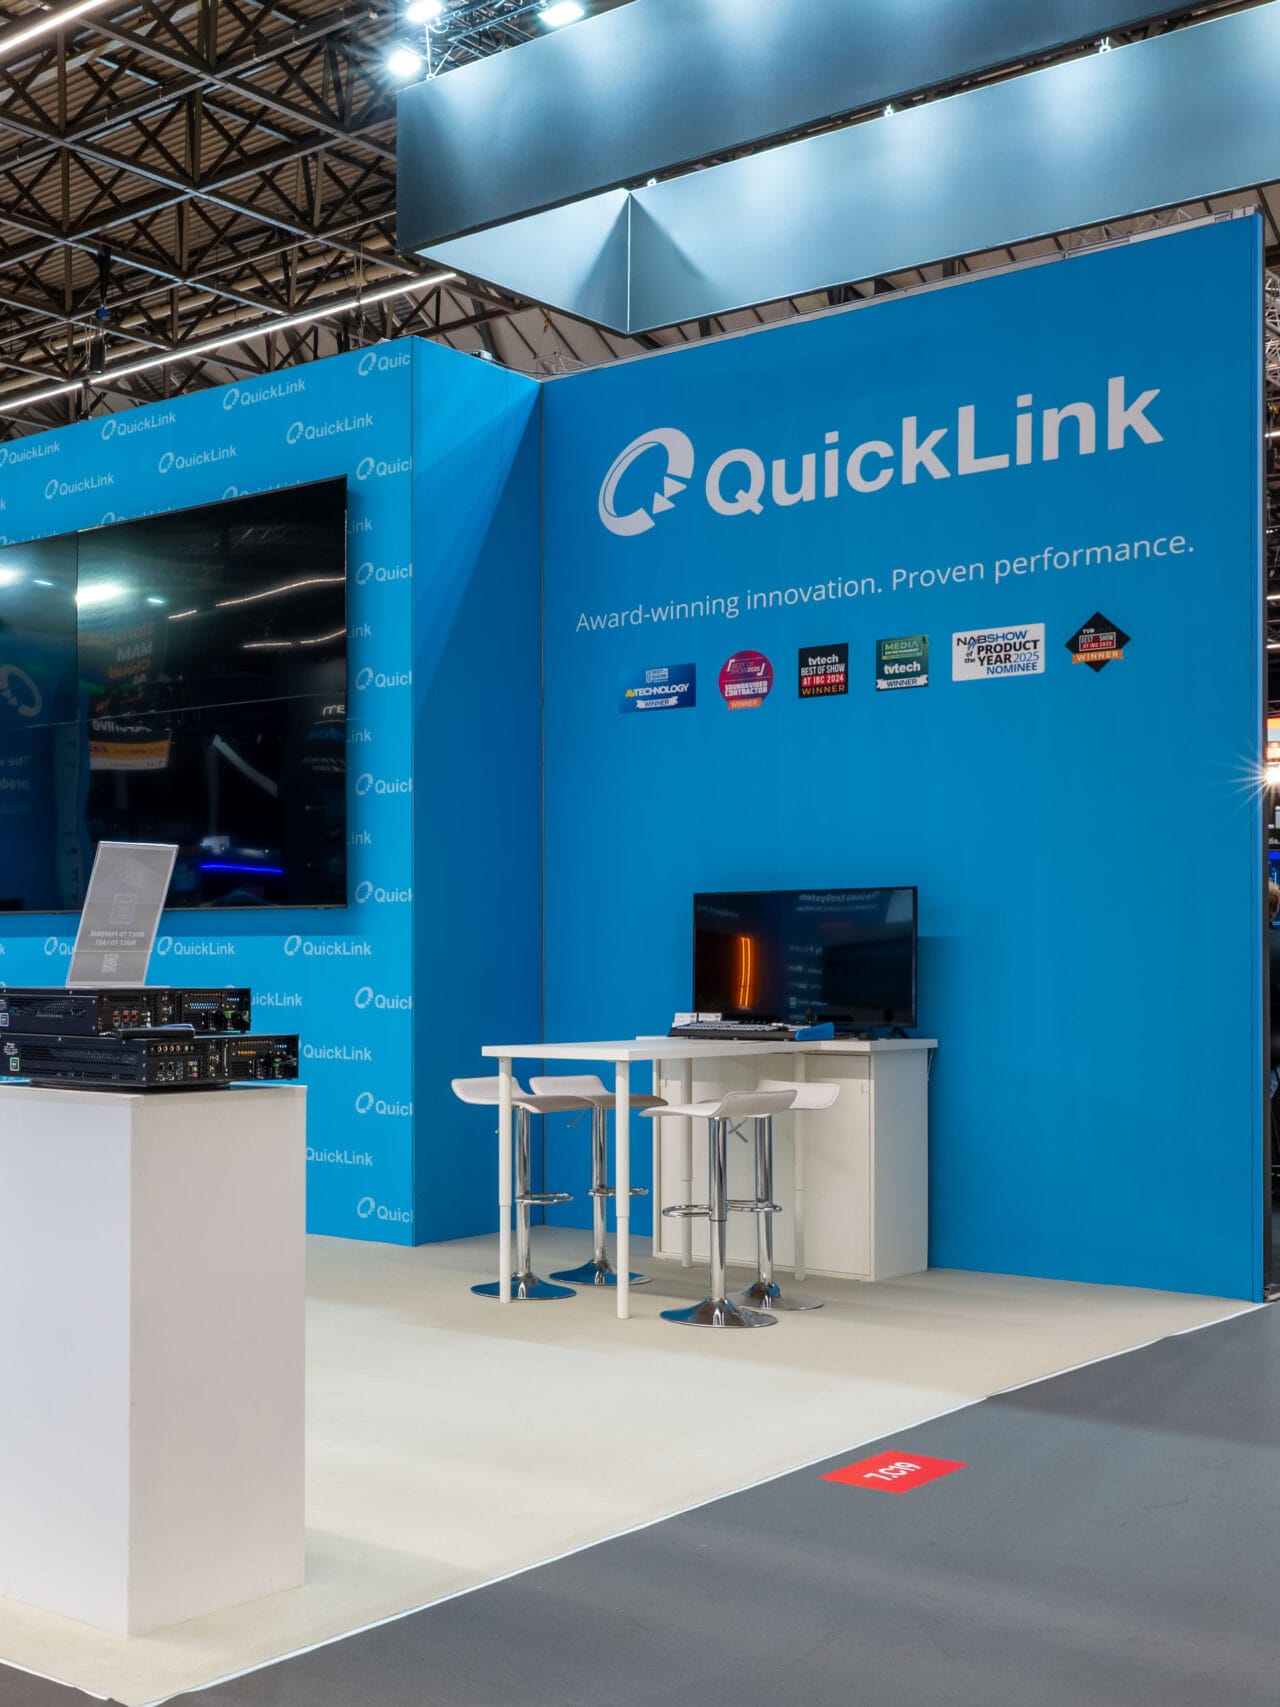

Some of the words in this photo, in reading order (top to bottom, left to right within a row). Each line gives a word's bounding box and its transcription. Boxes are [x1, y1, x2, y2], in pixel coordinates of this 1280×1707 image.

[241, 379, 305, 405] QuickLink
[115, 409, 175, 436] QuickLink
[305, 413, 373, 439] QuickLink
[9, 441, 60, 464] QuickLink
[706, 376, 1163, 515] QuickLink
[176, 445, 236, 469] QuickLink
[56, 473, 114, 495] QuickLink
[576, 596, 739, 631] Award-winning
[748, 577, 882, 609] innovation.
[893, 563, 984, 590] Proven
[995, 536, 1193, 581] performance.
[885, 641, 920, 651] MEDIA
[977, 640, 1040, 656] PRODUCT
[808, 654, 838, 666] tvtech
[978, 653, 1012, 666] YEAR
[1013, 651, 1040, 663] 2025
[1077, 651, 1119, 662] WINNER
[801, 665, 817, 676] BEST
[818, 664, 826, 675] OF
[826, 663, 845, 674] SHOW
[884, 661, 921, 675] tvtech
[987, 662, 1038, 675] NOMINEE
[802, 677, 811, 686] AT
[813, 676, 825, 684] IBC
[827, 674, 844, 683] 2024
[887, 679, 918, 688] WINNER
[725, 687, 768, 697] CONTRACTOR
[802, 685, 846, 696] WINNER
[644, 699, 670, 708] WINNER
[731, 700, 758, 709] WINNER
[174, 942, 235, 955] QuickLink
[303, 941, 371, 955] QuickLink
[252, 992, 302, 1007] uickLink
[303, 1044, 371, 1061] QuickLink
[305, 1146, 373, 1166] QuickLink
[864, 1461, 921, 1481] 7.C19
